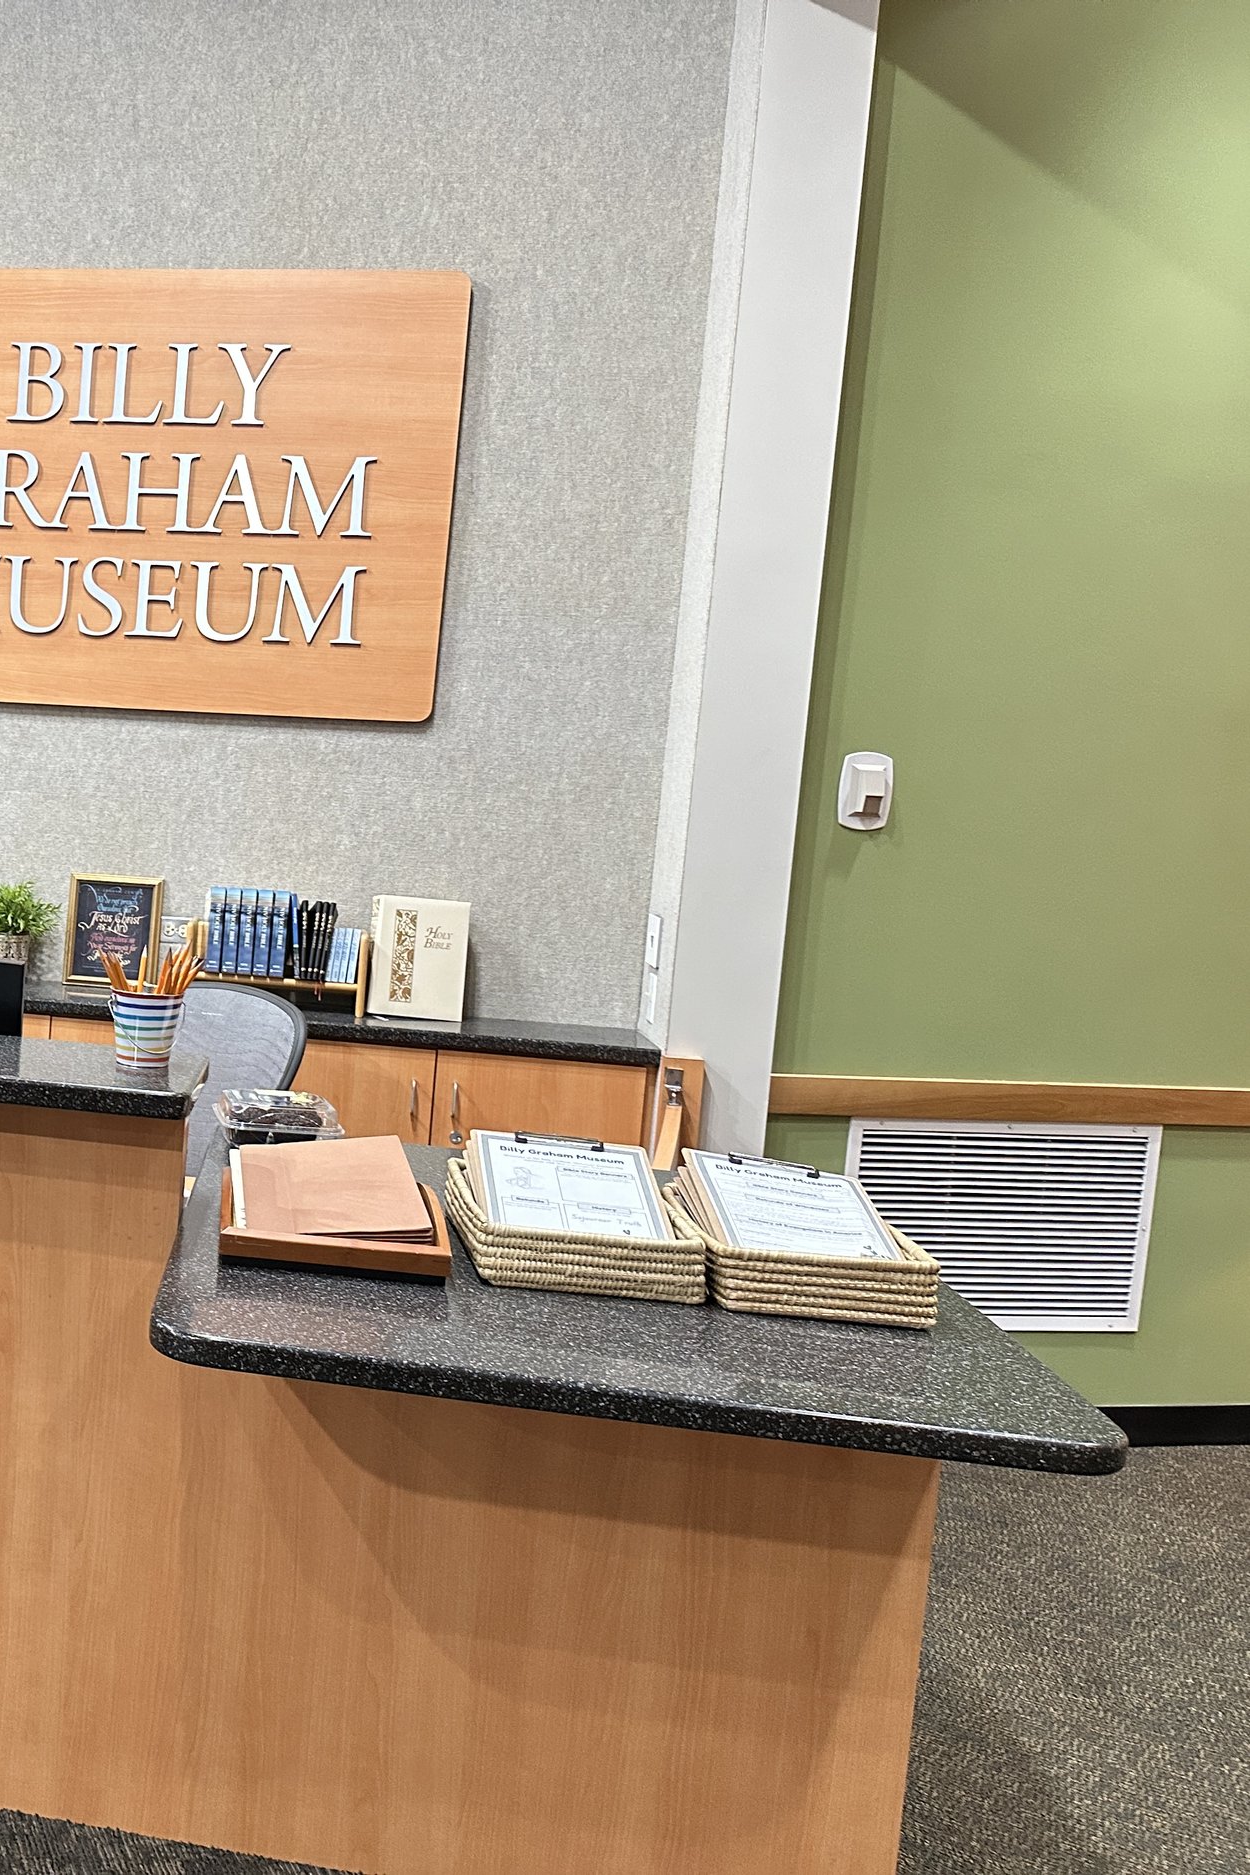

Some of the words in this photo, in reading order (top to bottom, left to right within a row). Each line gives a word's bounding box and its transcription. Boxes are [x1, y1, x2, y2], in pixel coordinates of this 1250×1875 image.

[6, 340, 292, 427] BILLY
[499, 1145, 526, 1156] Billy
[528, 1148, 574, 1160] Graham
[576, 1154, 625, 1165] Museum
[715, 1164, 741, 1174] Billy
[744, 1169, 791, 1181] Graham
[793, 1177, 843, 1188] Museum
